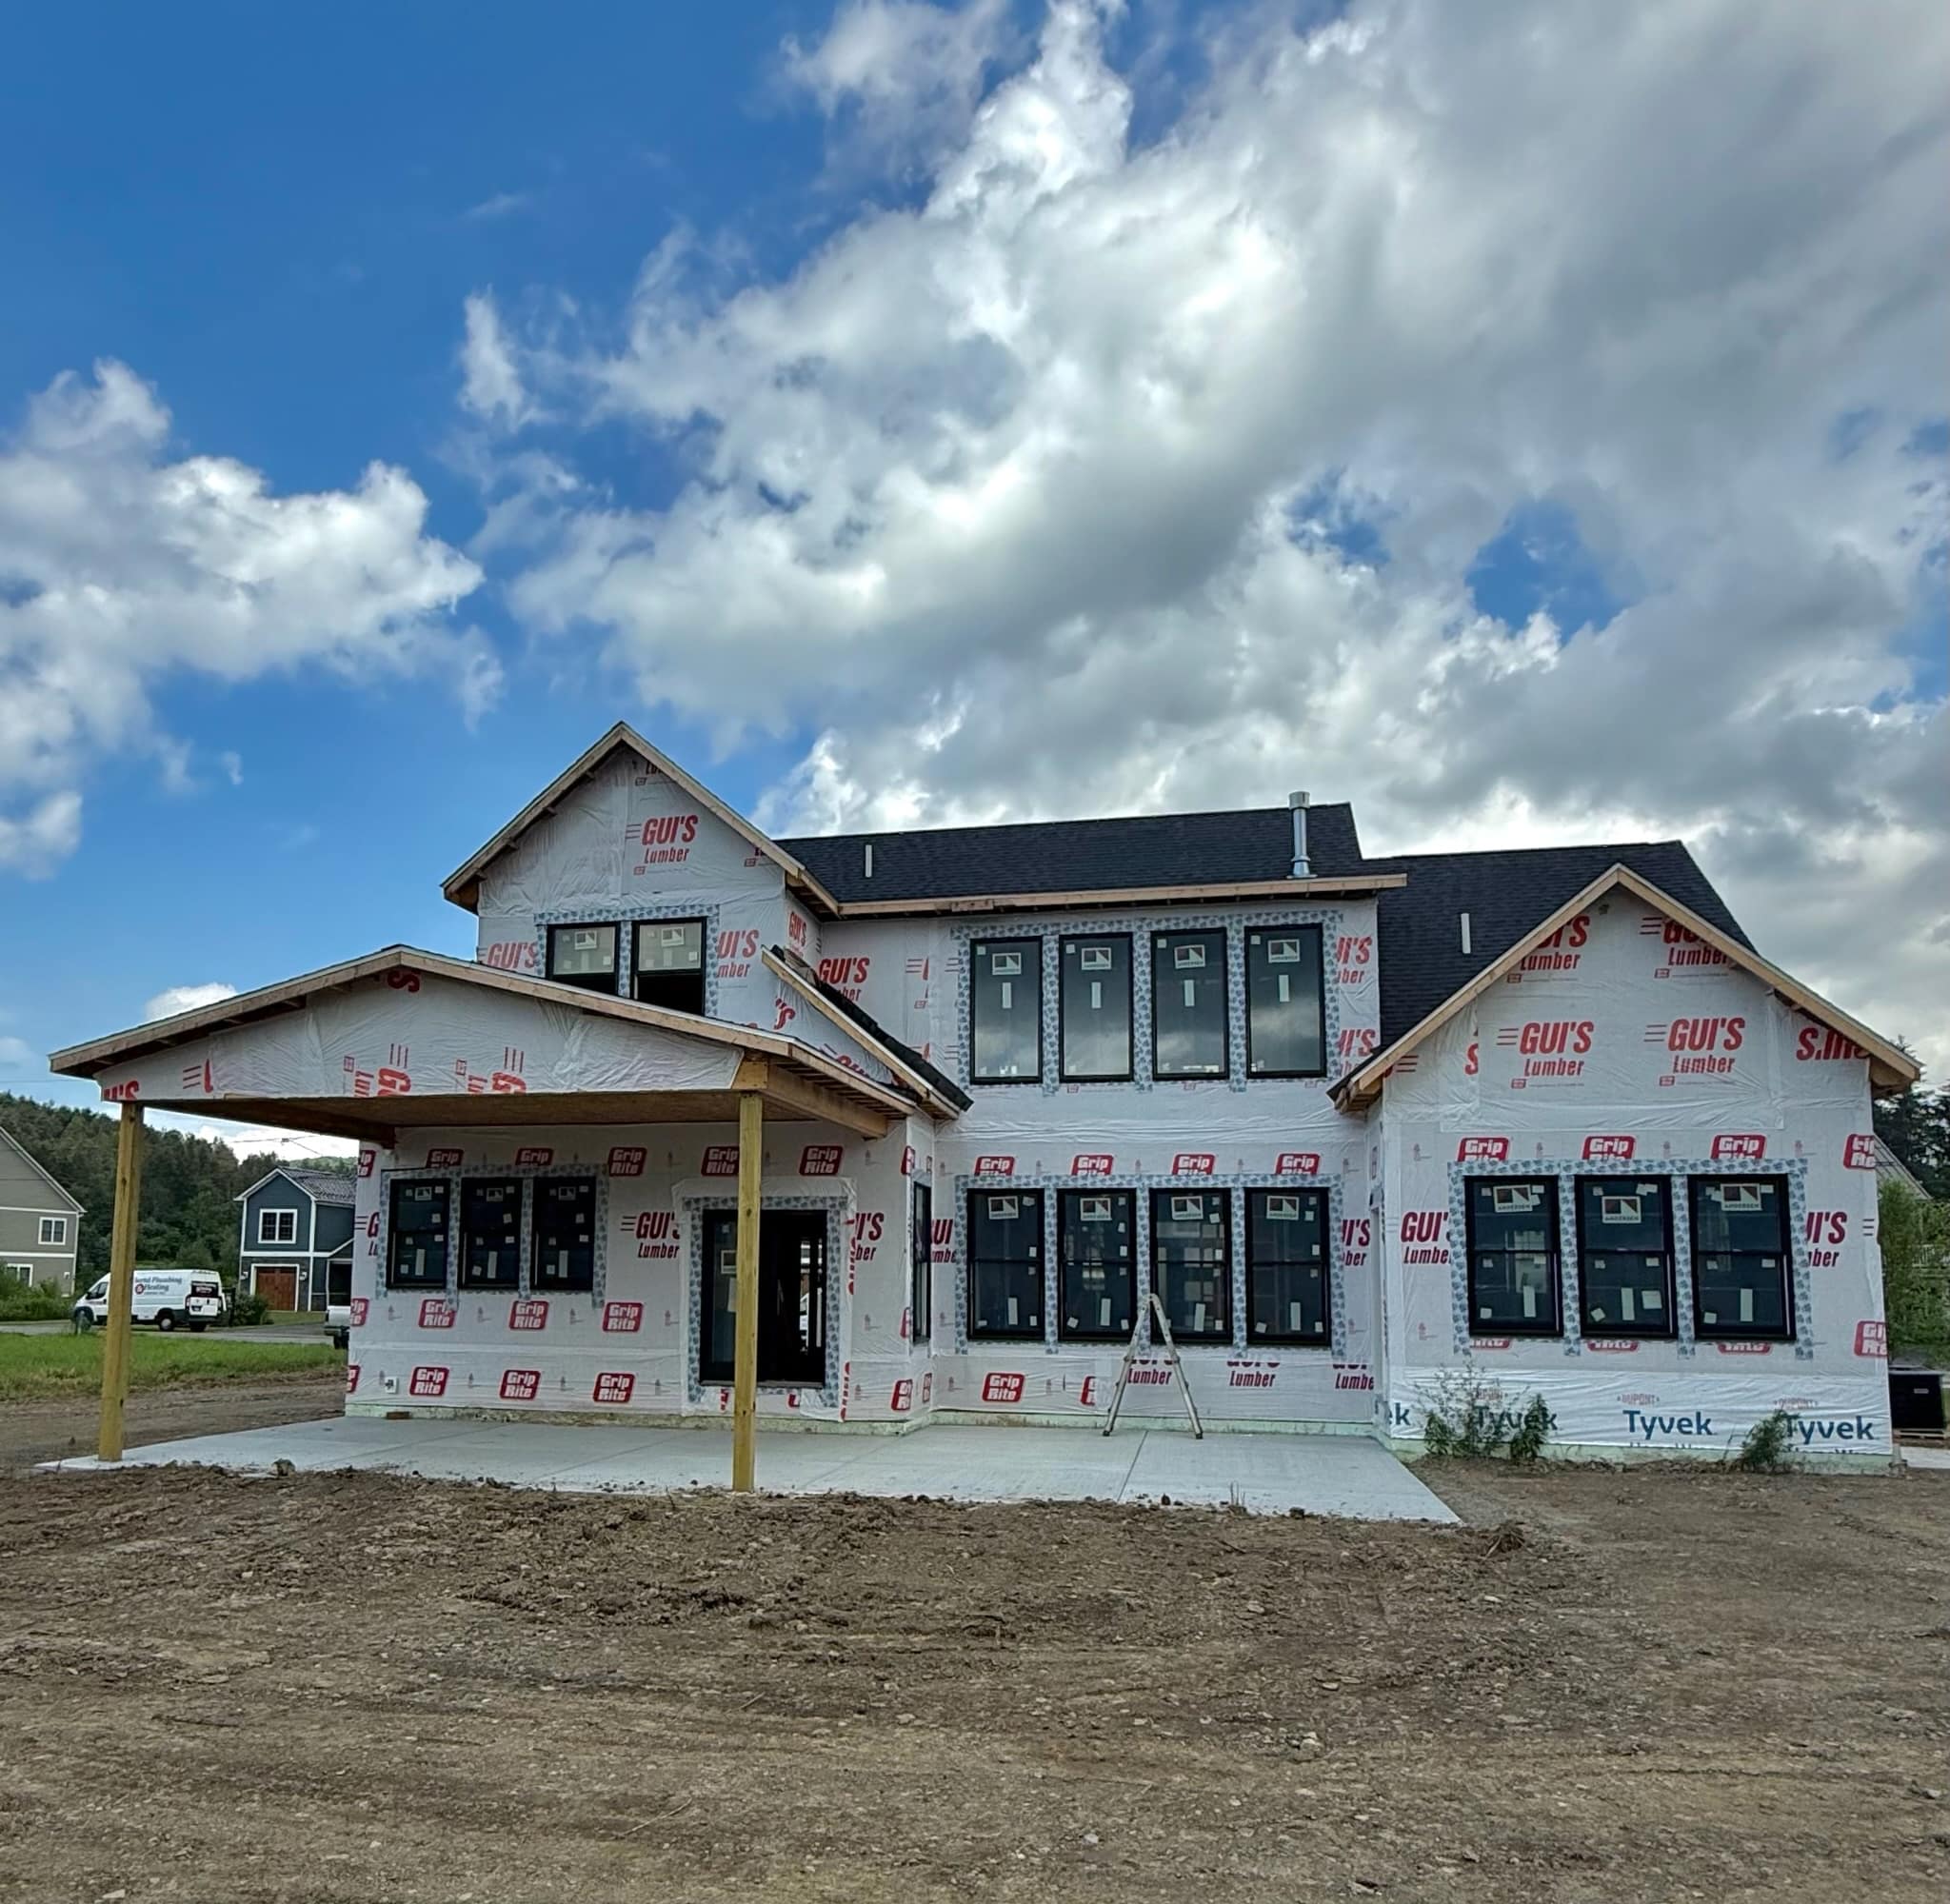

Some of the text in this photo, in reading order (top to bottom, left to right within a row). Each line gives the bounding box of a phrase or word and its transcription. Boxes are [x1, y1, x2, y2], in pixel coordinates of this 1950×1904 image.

[642, 815, 699, 845] GUI'S
[644, 847, 690, 864] Lumber
[717, 929, 760, 959] UI'S
[1521, 952, 1581, 970] Lumber
[716, 962, 750, 978] mber
[819, 957, 870, 984] GUI'S
[1520, 1021, 1594, 1054] GUI'S
[1668, 1018, 1744, 1051] GUI'S
[1524, 1058, 1584, 1077] Lumber
[1673, 1055, 1735, 1073] Lumber
[1464, 1140, 1502, 1155] Grip
[1589, 1138, 1629, 1155] Grip
[1718, 1137, 1760, 1153] Grip
[429, 1150, 460, 1164] Grip
[521, 1150, 549, 1164] Grip
[613, 1149, 643, 1162] Grip
[708, 1148, 739, 1162] Grip
[807, 1148, 838, 1162] Grip
[610, 1162, 639, 1174] Rite
[706, 1161, 735, 1174] Rite
[805, 1161, 834, 1174] Rite
[980, 1158, 1010, 1171] Grip
[1077, 1156, 1108, 1171] Grip
[1178, 1156, 1210, 1170] Grip
[1282, 1155, 1314, 1170] Grip
[1401, 1212, 1451, 1242] GUI'
[638, 1242, 680, 1259] Lumber
[516, 1303, 546, 1317] Grip
[608, 1305, 639, 1319] Grip
[424, 1314, 450, 1326] Rite
[514, 1316, 542, 1328] Rite
[607, 1318, 635, 1330] Rite
[416, 1369, 446, 1382] Grip
[507, 1372, 536, 1386] Grip
[601, 1375, 630, 1389] Grip
[1127, 1368, 1172, 1385] Lumber
[1229, 1371, 1276, 1387] Lumber
[1335, 1374, 1374, 1390] Lumbe
[414, 1381, 442, 1394] Rite
[988, 1376, 1021, 1390] Grip
[505, 1385, 532, 1398] Rite
[598, 1387, 627, 1400] Rite
[986, 1388, 1017, 1400] Rite
[1622, 1410, 1713, 1440] Tyvek
[1782, 1415, 1874, 1445] Tyvek
